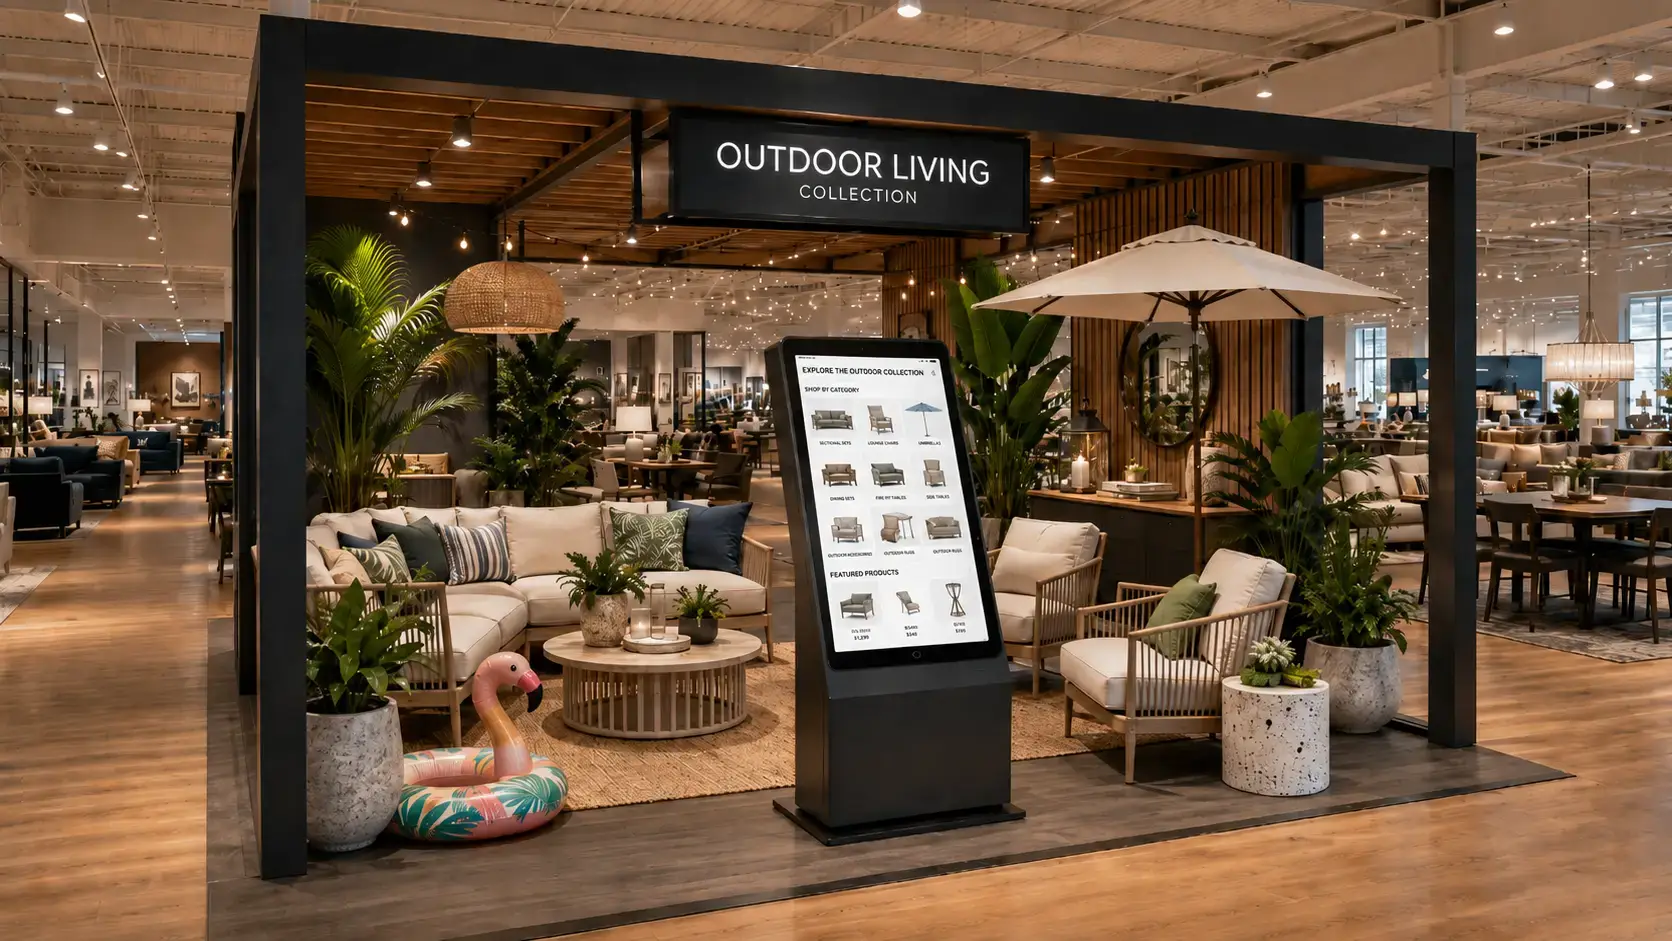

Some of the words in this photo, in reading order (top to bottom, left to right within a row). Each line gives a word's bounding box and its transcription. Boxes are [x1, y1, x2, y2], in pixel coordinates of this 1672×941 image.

[716, 141, 882, 179] OUTDOOR
[893, 154, 990, 186] LIVING
[799, 184, 917, 204] COLLECTION
[802, 366, 834, 374] EXPLORE
[835, 367, 848, 375] THE
[883, 368, 924, 376] COLLECTION
[830, 570, 864, 578] FEATURED
[864, 569, 899, 577] PRODUCTS
